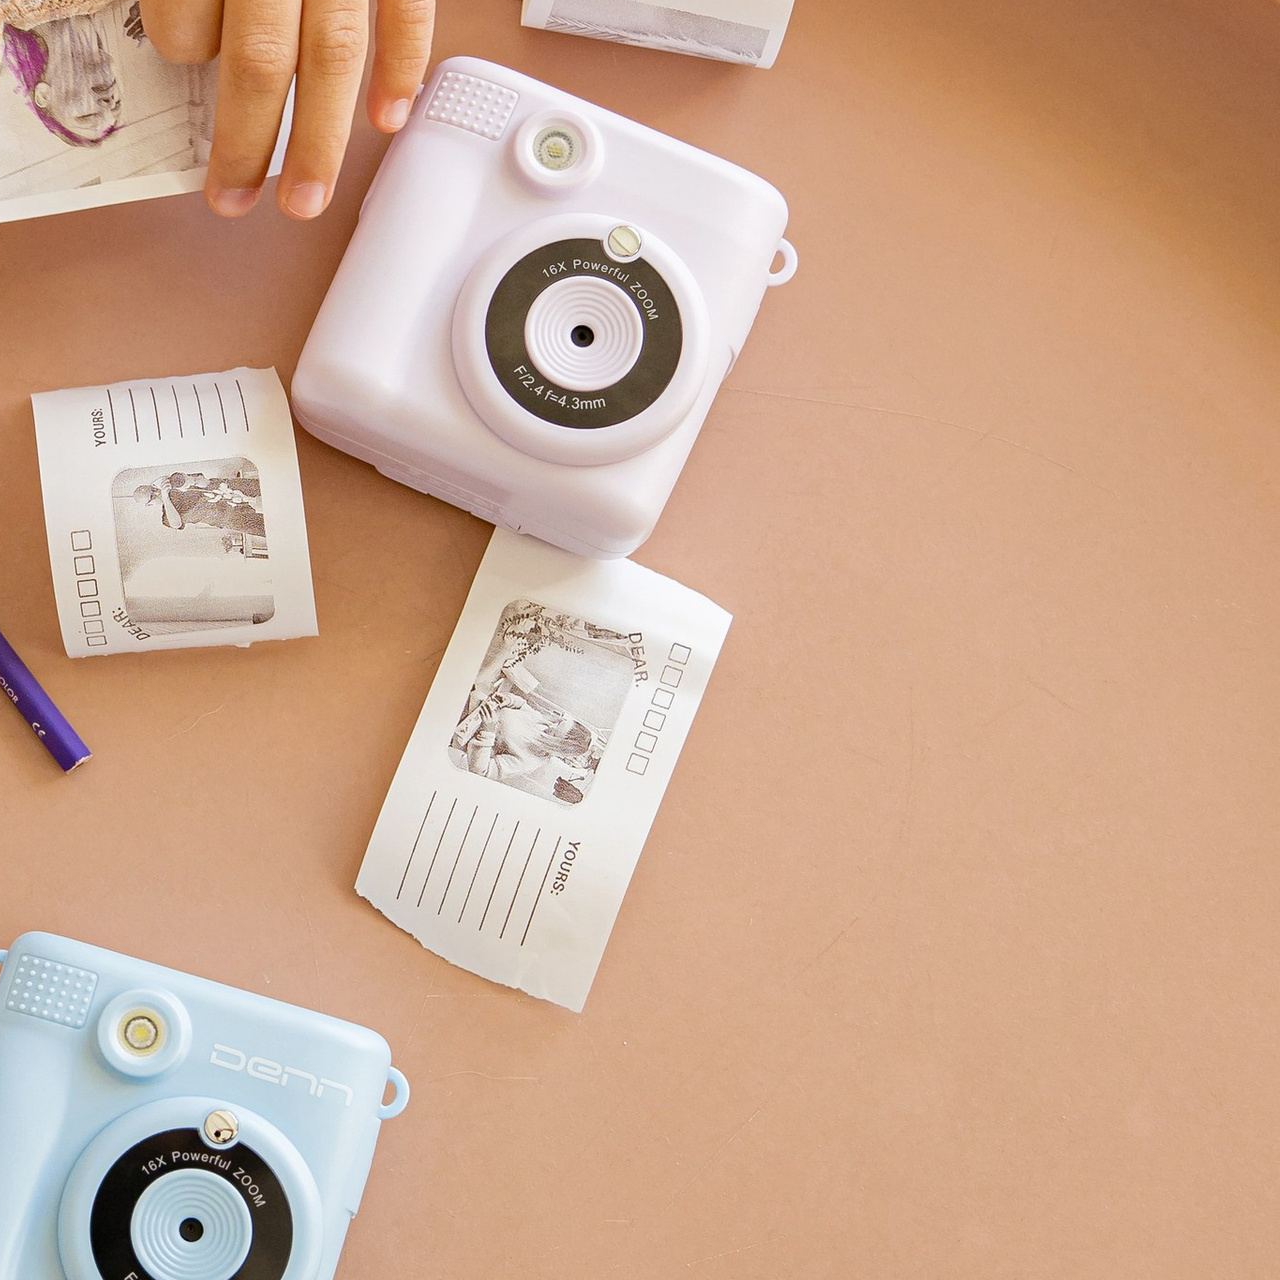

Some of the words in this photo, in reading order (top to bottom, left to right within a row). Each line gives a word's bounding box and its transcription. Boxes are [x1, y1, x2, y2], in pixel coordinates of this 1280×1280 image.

[542, 261, 567, 279] 16X
[572, 258, 630, 283] Powerful
[629, 281, 659, 321] ZOOM
[513, 365, 544, 397] F/2.4
[544, 389, 607, 410] f=4.3mm
[91, 408, 107, 448] YOURS:
[550, 841, 581, 896] YOURS:
[141, 1155, 167, 1176] 16X
[171, 1150, 233, 1171] Powerful
[233, 1167, 266, 1209] ZOOM
